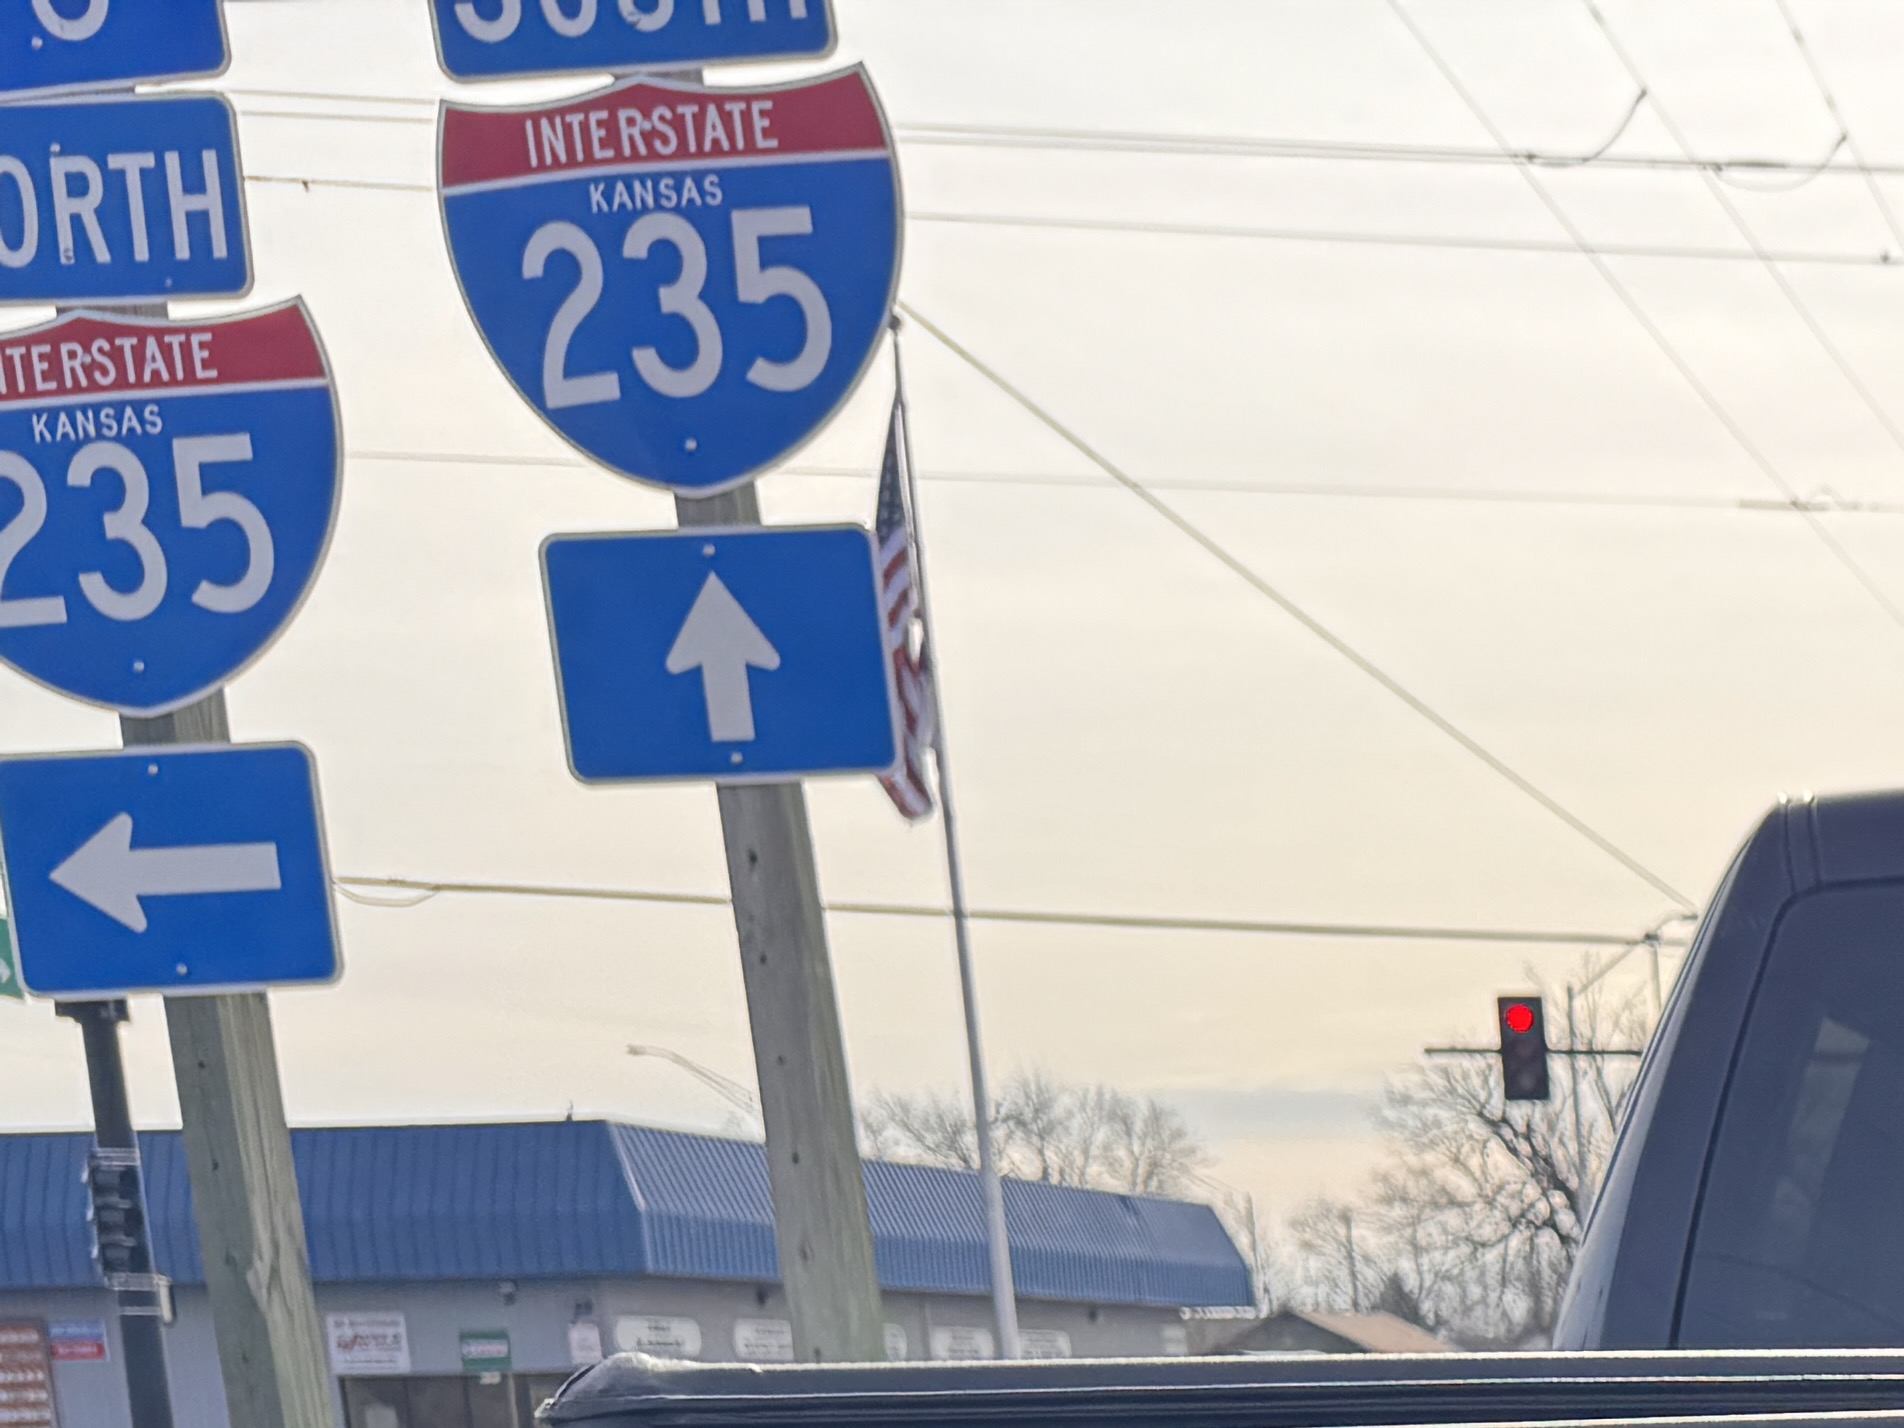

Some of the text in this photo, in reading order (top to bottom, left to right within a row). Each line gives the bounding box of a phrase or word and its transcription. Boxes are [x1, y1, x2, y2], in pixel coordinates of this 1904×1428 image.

[525, 100, 778, 168] INTERSTATE
[588, 174, 723, 214] KANSAS
[522, 206, 832, 409] 235
[0, 332, 218, 394] TERSTATE
[31, 403, 163, 443] KANSAS
[0, 432, 275, 628] 235
